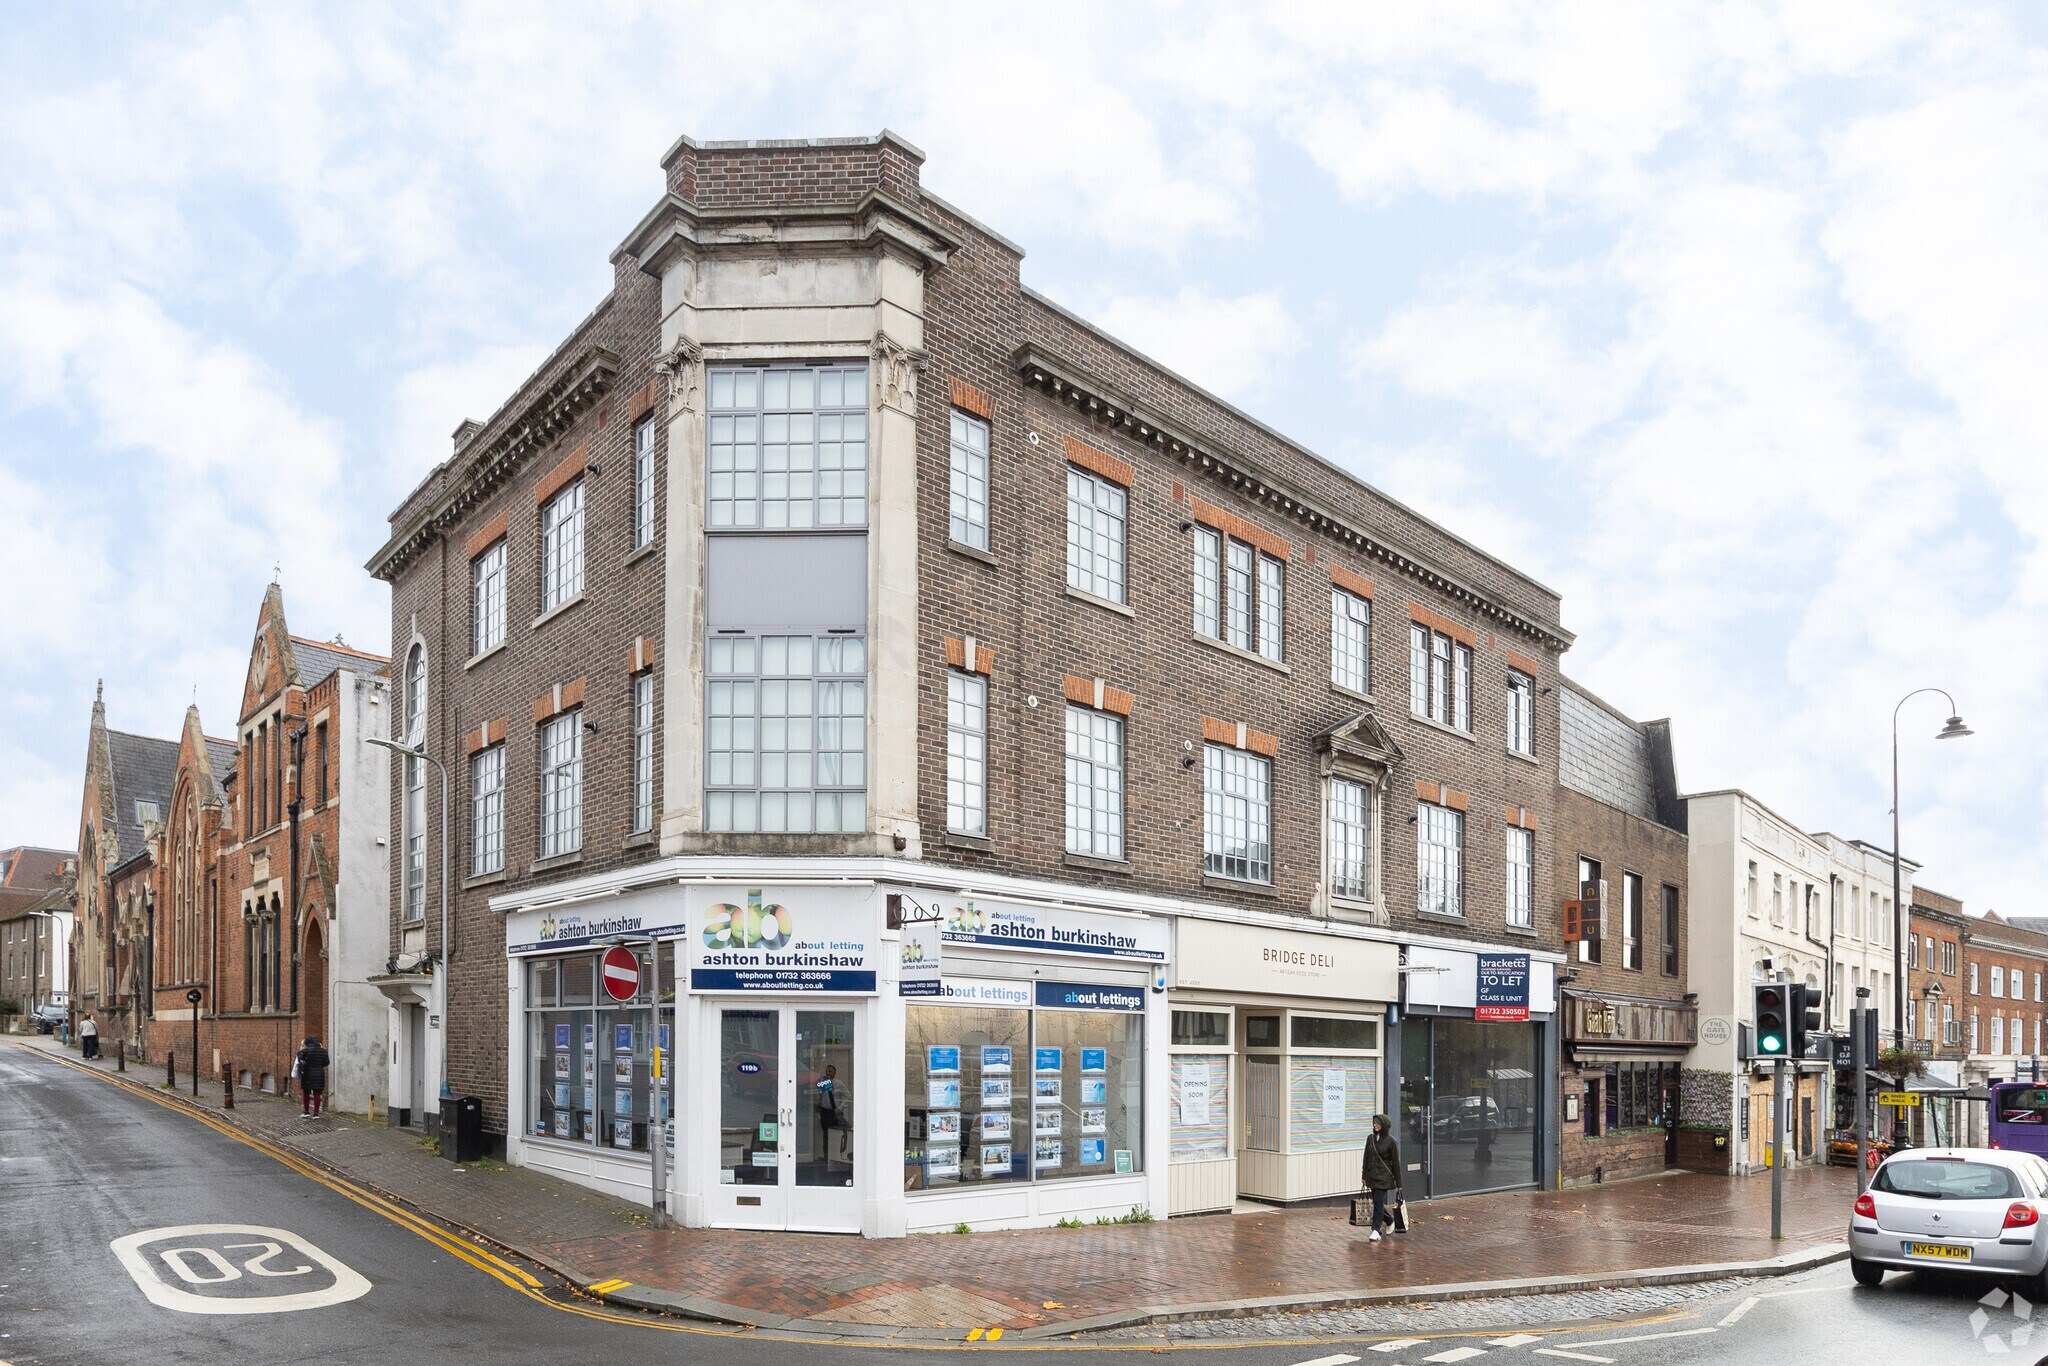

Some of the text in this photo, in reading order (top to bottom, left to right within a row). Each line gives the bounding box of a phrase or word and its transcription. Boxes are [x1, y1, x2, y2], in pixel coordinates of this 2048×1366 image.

[702, 889, 793, 951] ab
[948, 901, 987, 934] ab
[991, 912, 1035, 924] about letting
[559, 915, 642, 939] ashton burkinshaw
[990, 922, 1136, 948] ashton burkinshaw
[795, 941, 864, 952] about letting
[702, 952, 864, 966] ashton burkinshaw
[1263, 948, 1334, 968] BRIDGE DELI
[1481, 959, 1526, 968] bracketts
[735, 972, 773, 980] telephone
[1481, 976, 1523, 986] TO LET
[743, 982, 824, 990] www.aboutletting.co.uk
[940, 985, 1028, 1002] about lettings
[1065, 992, 1140, 1007] about lettings
[1912, 1244, 1968, 1257] NX57 WDM
[160, 1242, 313, 1284] 20
